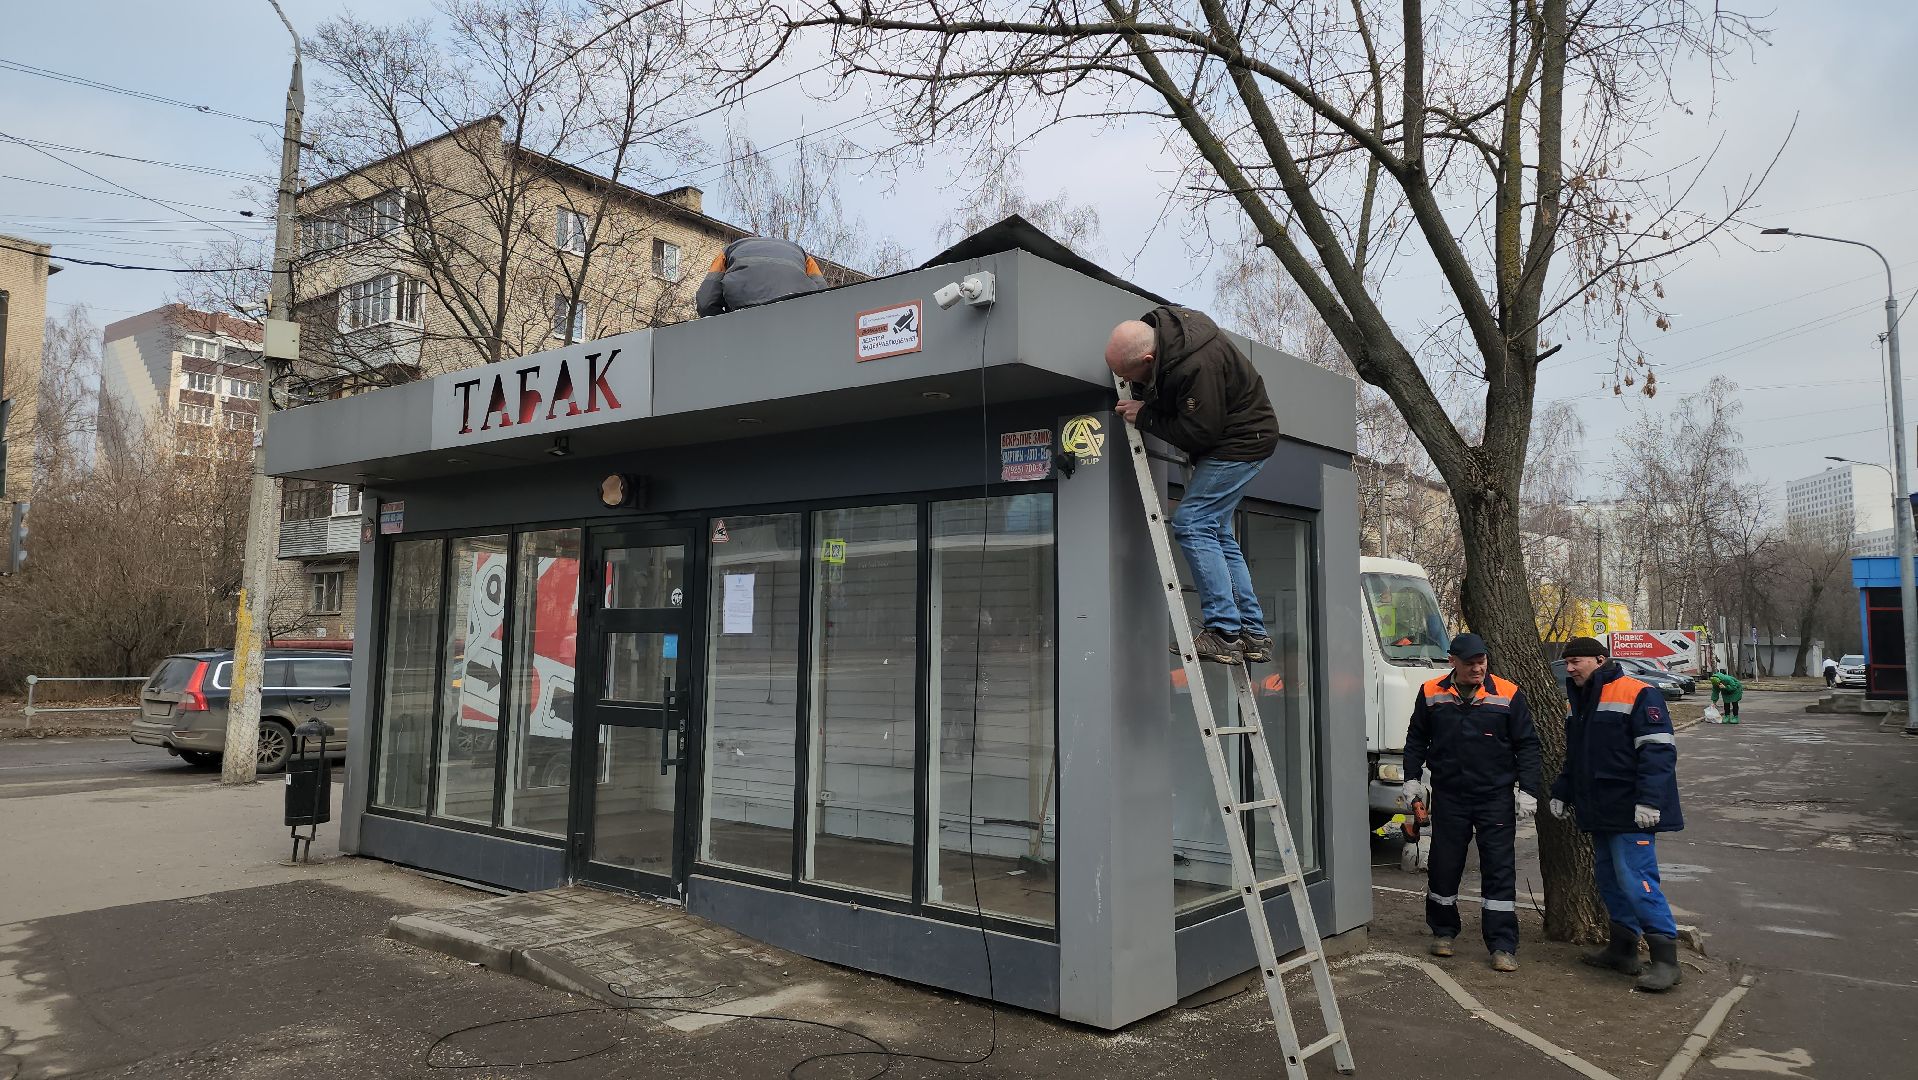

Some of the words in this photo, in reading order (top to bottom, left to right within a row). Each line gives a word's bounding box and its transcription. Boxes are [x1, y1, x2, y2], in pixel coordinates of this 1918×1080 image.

[454, 349, 622, 434] ТАБАК
[1033, 430, 1051, 445] ЗАМК
[1613, 633, 1644, 641] Яндекс
[1613, 641, 1653, 649] Доставка
